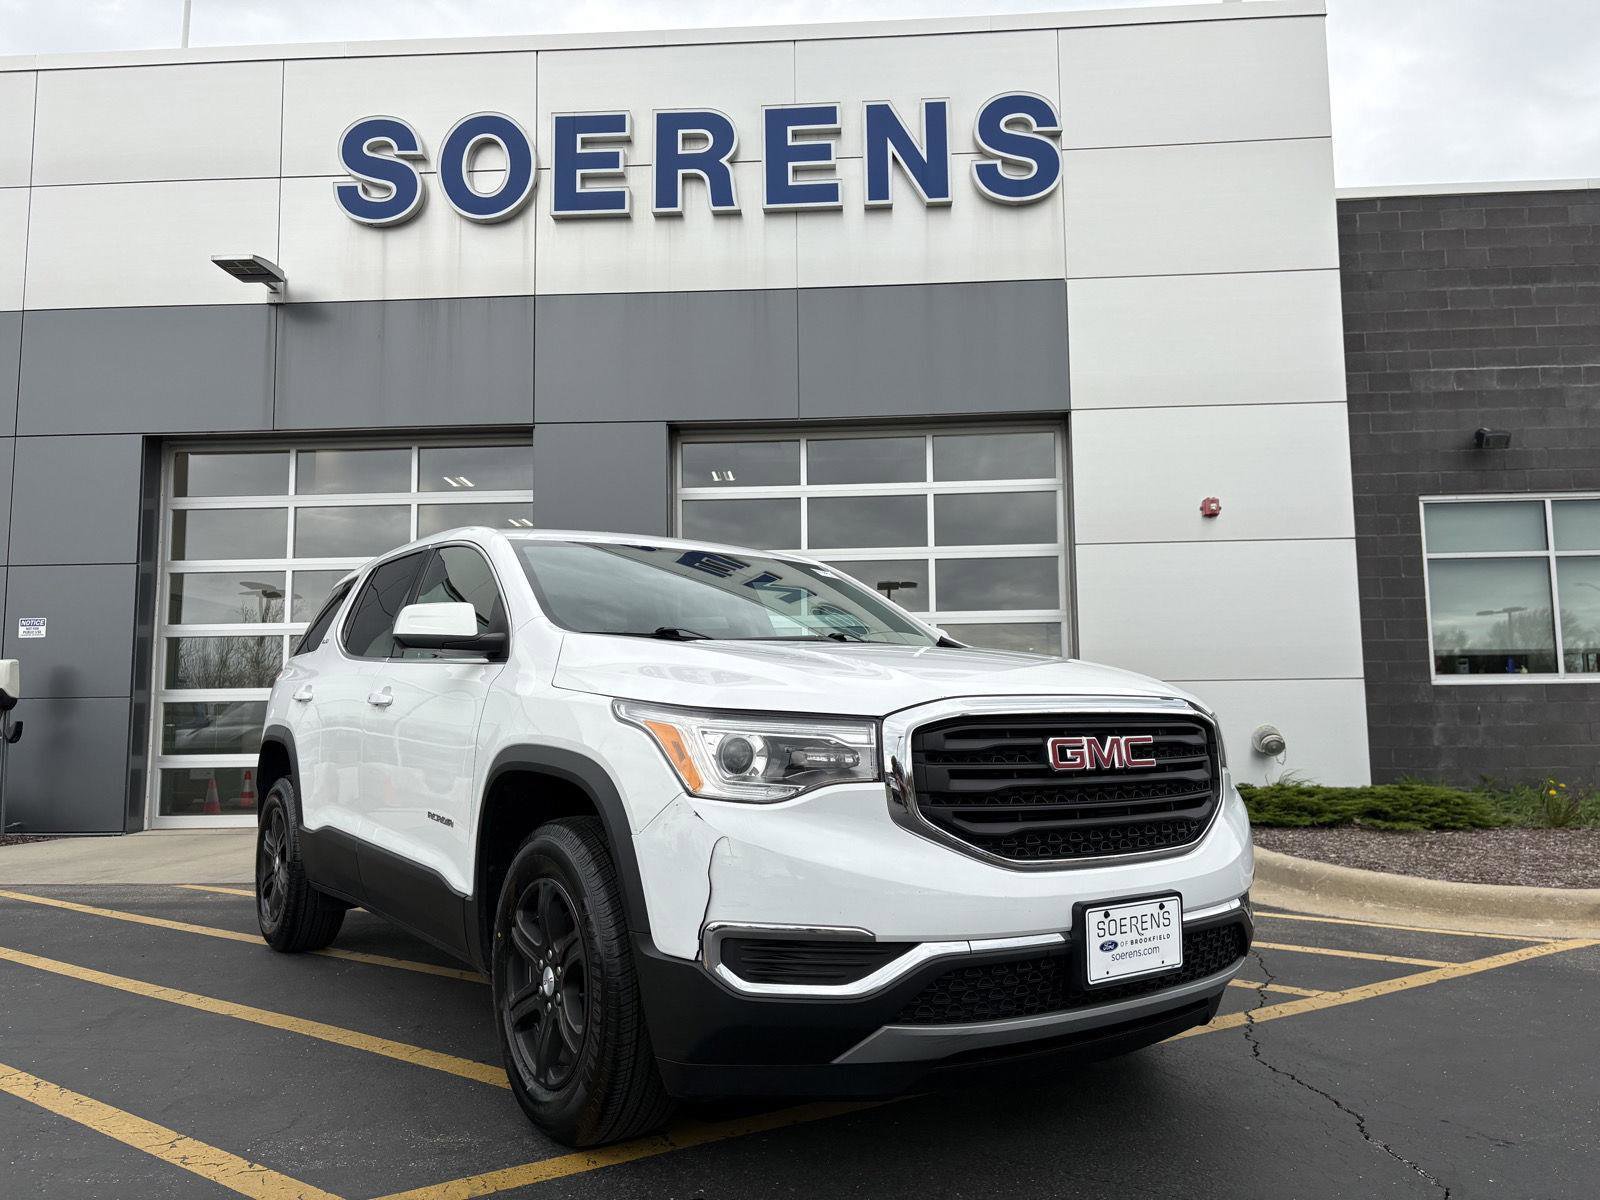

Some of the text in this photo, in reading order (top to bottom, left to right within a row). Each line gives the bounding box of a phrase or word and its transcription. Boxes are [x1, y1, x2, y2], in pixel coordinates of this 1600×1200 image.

[332, 90, 1063, 227] SOERENS
[1047, 735, 1156, 771] GMC
[1096, 910, 1171, 938] SOERENS
[1130, 933, 1171, 945] BROOKFIELD
[1111, 946, 1160, 961] soerens.com
